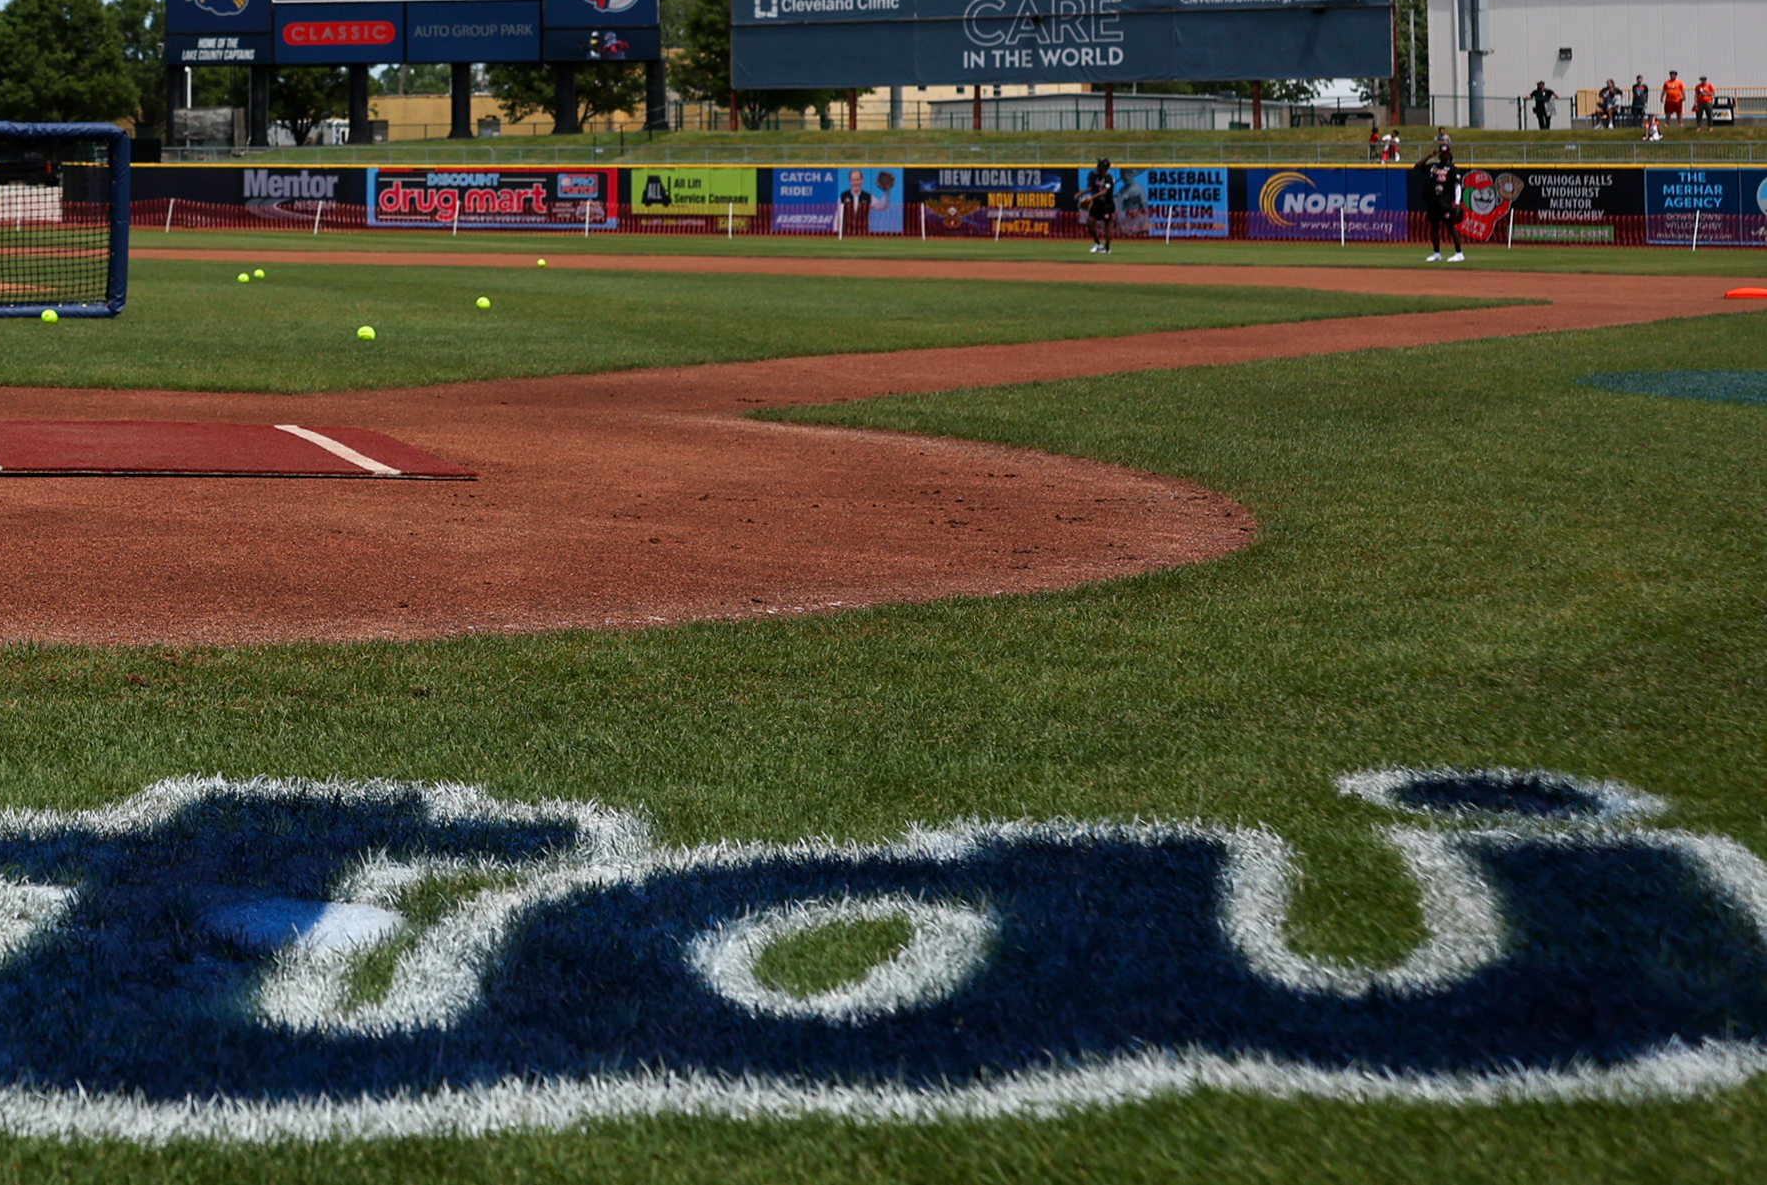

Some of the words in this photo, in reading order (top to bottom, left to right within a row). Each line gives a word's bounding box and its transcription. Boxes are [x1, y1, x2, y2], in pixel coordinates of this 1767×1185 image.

[291, 24, 386, 41] CLASSIC
[414, 24, 448, 37] AUTO
[451, 24, 498, 37] GROUP
[501, 23, 533, 35] PARK
[197, 38, 217, 48] HOME
[217, 38, 226, 48] OF
[227, 37, 239, 48] THE
[181, 49, 197, 61] LAKE
[198, 49, 223, 60] COUNTY
[224, 49, 255, 60] CAPTAINS
[963, 50, 985, 69] IN
[991, 49, 1033, 68] THE
[1039, 47, 1124, 66] WORLD
[427, 173, 499, 186] DISCOUNT
[780, 172, 821, 182] CATCH
[824, 172, 834, 182] A
[939, 170, 971, 186] IBEW
[975, 170, 1014, 186] LOCAL
[1017, 170, 1041, 186] 673
[1148, 171, 1223, 185] BASEBALL
[1528, 175, 1581, 186] CUYAHOGA
[1583, 175, 1613, 186] FALLS
[1678, 172, 1706, 183] THE
[243, 169, 339, 198] Mentor
[674, 178, 685, 189] All
[688, 178, 702, 189] Lift
[1663, 184, 1723, 195] MERHAR
[647, 183, 662, 199] ALL
[780, 186, 813, 196] RIDE!
[1148, 187, 1221, 201] HERITAGE
[1541, 187, 1600, 198] LYNDHURST
[379, 181, 458, 222] drug
[464, 183, 547, 213] mart
[674, 193, 706, 204] Service
[708, 194, 749, 205] Company
[988, 193, 1014, 207] NOW
[1016, 193, 1056, 207] HIRING
[1283, 193, 1377, 214] NOPEC
[1550, 199, 1592, 209] MENTOR
[1664, 197, 1722, 208] AGENCY
[1148, 204, 1213, 218] MUSEUM
[1538, 210, 1604, 221] WILLOUGHBY
